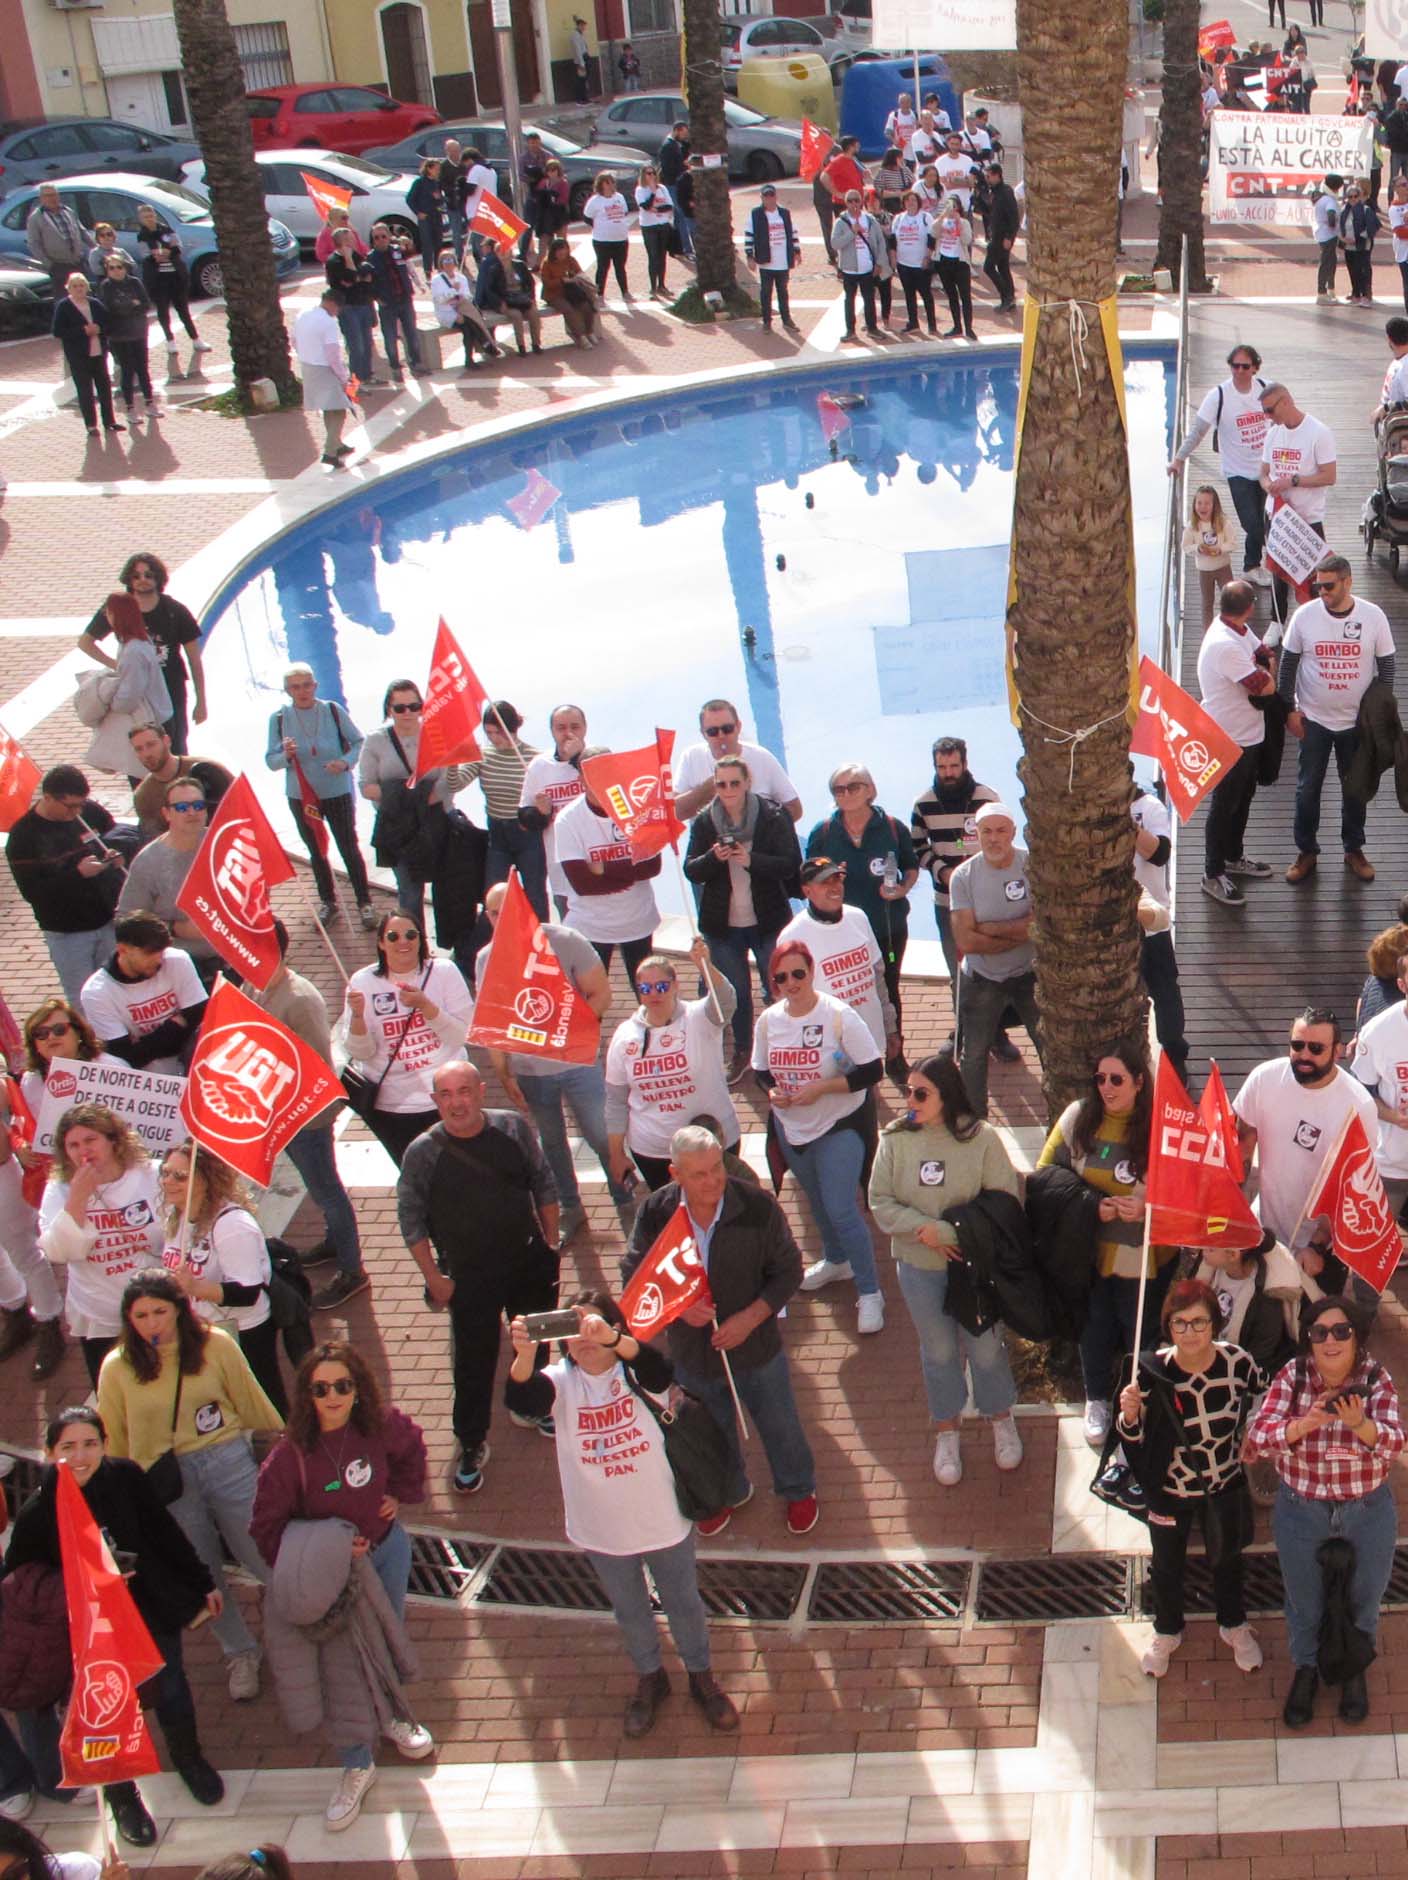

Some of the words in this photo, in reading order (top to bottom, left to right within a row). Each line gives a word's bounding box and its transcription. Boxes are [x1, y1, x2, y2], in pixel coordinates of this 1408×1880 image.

[1243, 126, 1264, 144] LA
[1276, 128, 1342, 147] LLUITA
[1271, 148, 1294, 167] AL
[1299, 149, 1364, 170] CARRER
[1272, 450, 1302, 461] BIMBO
[1314, 644, 1361, 656] BIMBO
[1332, 661, 1359, 669] LLEVA
[1319, 672, 1360, 680] NUESTRO
[1138, 685, 1188, 743] UT
[822, 947, 870, 977] BIMBO
[831, 978, 846, 990] SE
[847, 967, 873, 984] LLEVA
[383, 1013, 426, 1036] BIMB
[633, 1053, 688, 1076] BIMBO
[769, 1049, 820, 1066] BIMBO
[210, 1031, 296, 1109] UGT
[774, 1072, 784, 1080] SE
[78, 1066, 97, 1082] DE
[98, 1069, 141, 1090] NORTE
[143, 1077, 152, 1092] A
[154, 1079, 182, 1097] SUR,
[638, 1083, 653, 1091] SE
[655, 1075, 692, 1090] LLEVA
[642, 1085, 696, 1102] NUESTRO
[74, 1090, 92, 1105] DE
[125, 1098, 135, 1113] A
[138, 1100, 178, 1119] OESTE
[659, 1103, 687, 1113] PAN.
[107, 1232, 148, 1248] LLEVA
[106, 1261, 137, 1276] PAN.
[604, 1427, 643, 1449] LLEVA
[582, 1441, 650, 1465] NUESTRO
[605, 1464, 639, 1477] PAN.
